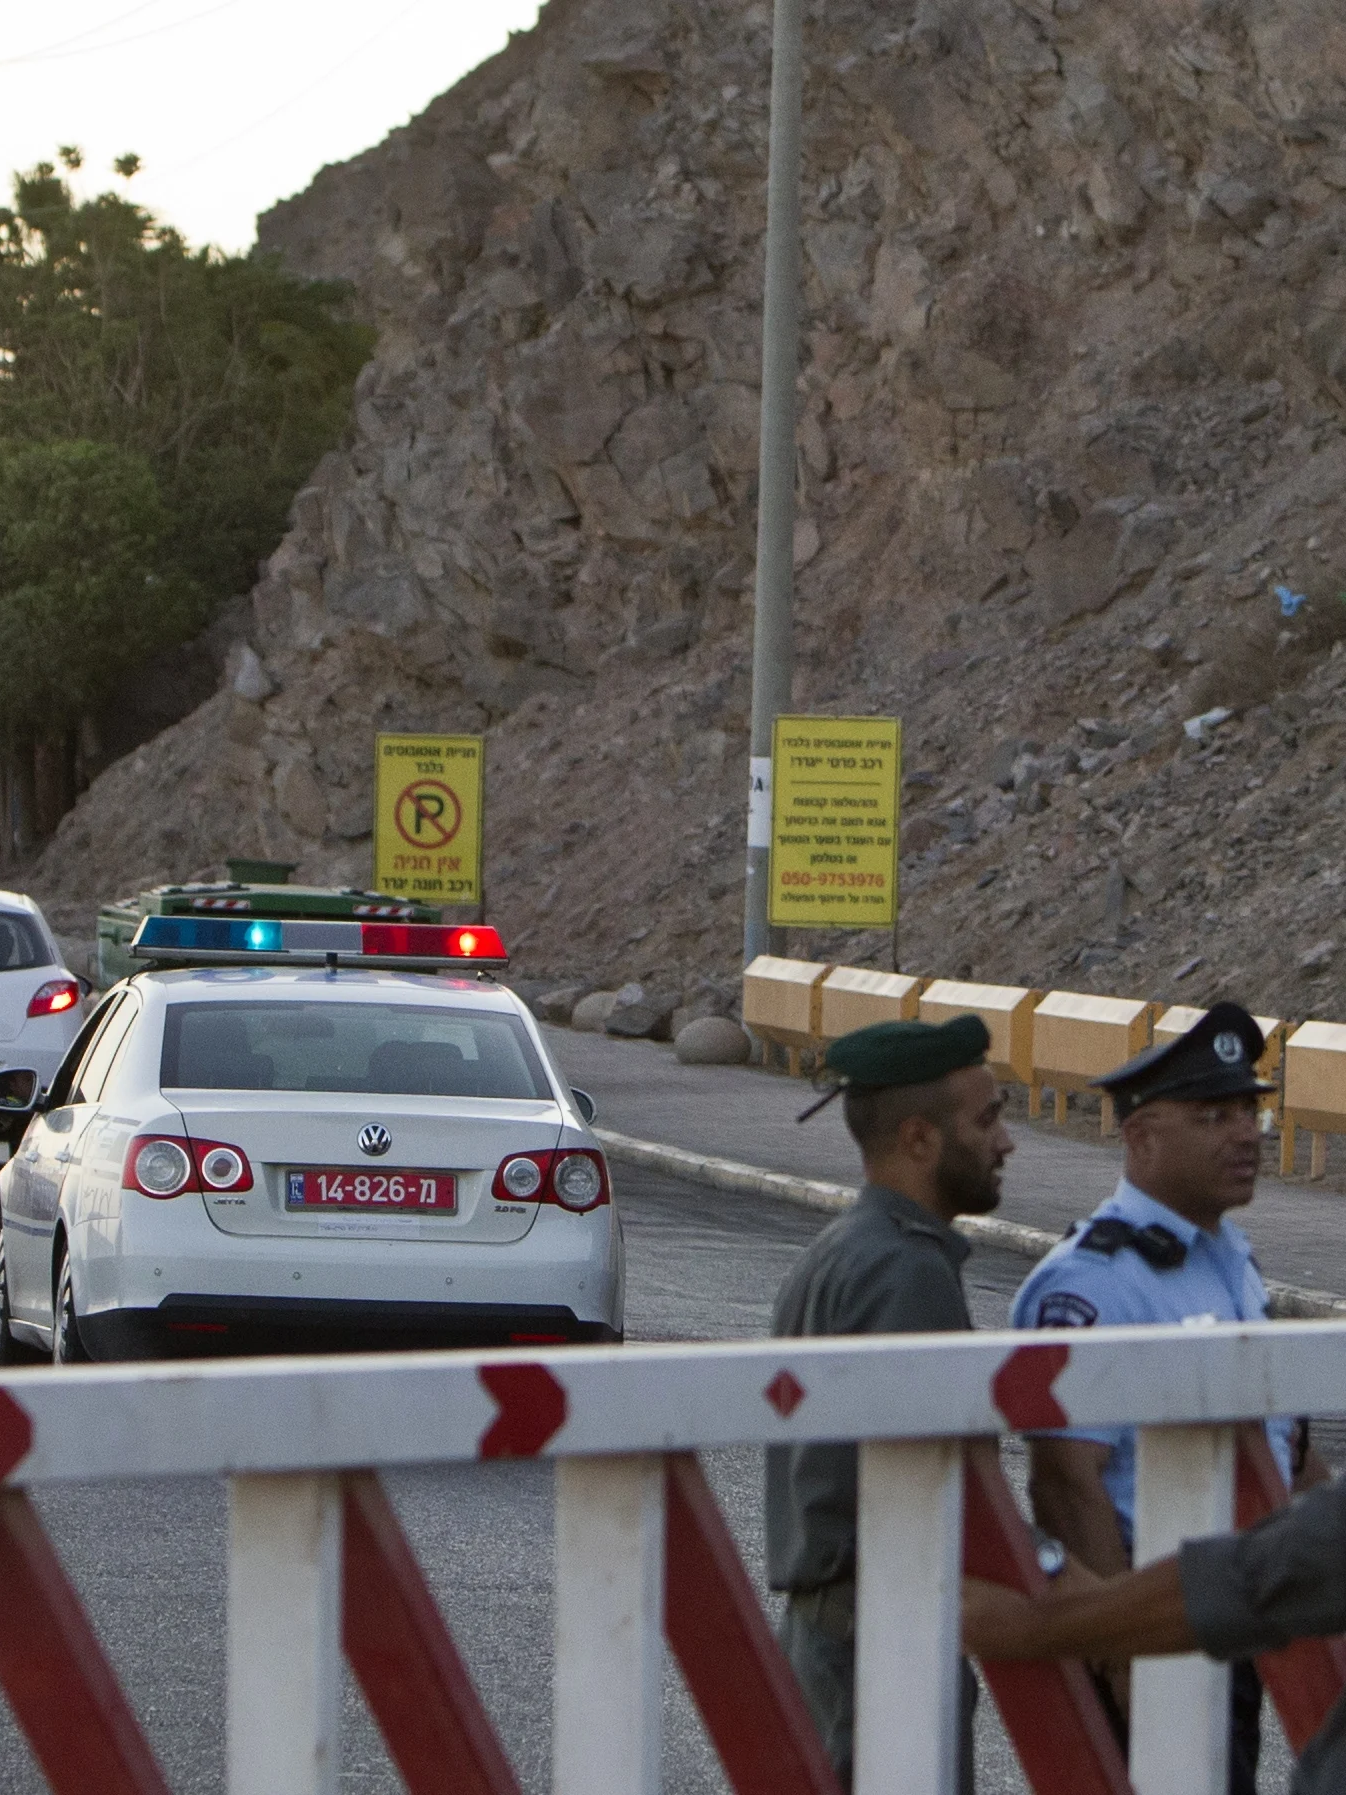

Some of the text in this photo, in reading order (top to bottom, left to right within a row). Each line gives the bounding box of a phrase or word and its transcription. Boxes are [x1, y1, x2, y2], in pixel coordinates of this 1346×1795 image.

[813, 738, 862, 749] אוטובוסים
[383, 745, 476, 758] חניית אוטובוסים
[827, 756, 857, 769] פרטי
[859, 758, 883, 769] רכב
[415, 793, 444, 834] P
[393, 854, 461, 873] אין חניה
[413, 878, 443, 891] חונה
[448, 880, 472, 892] רכב
